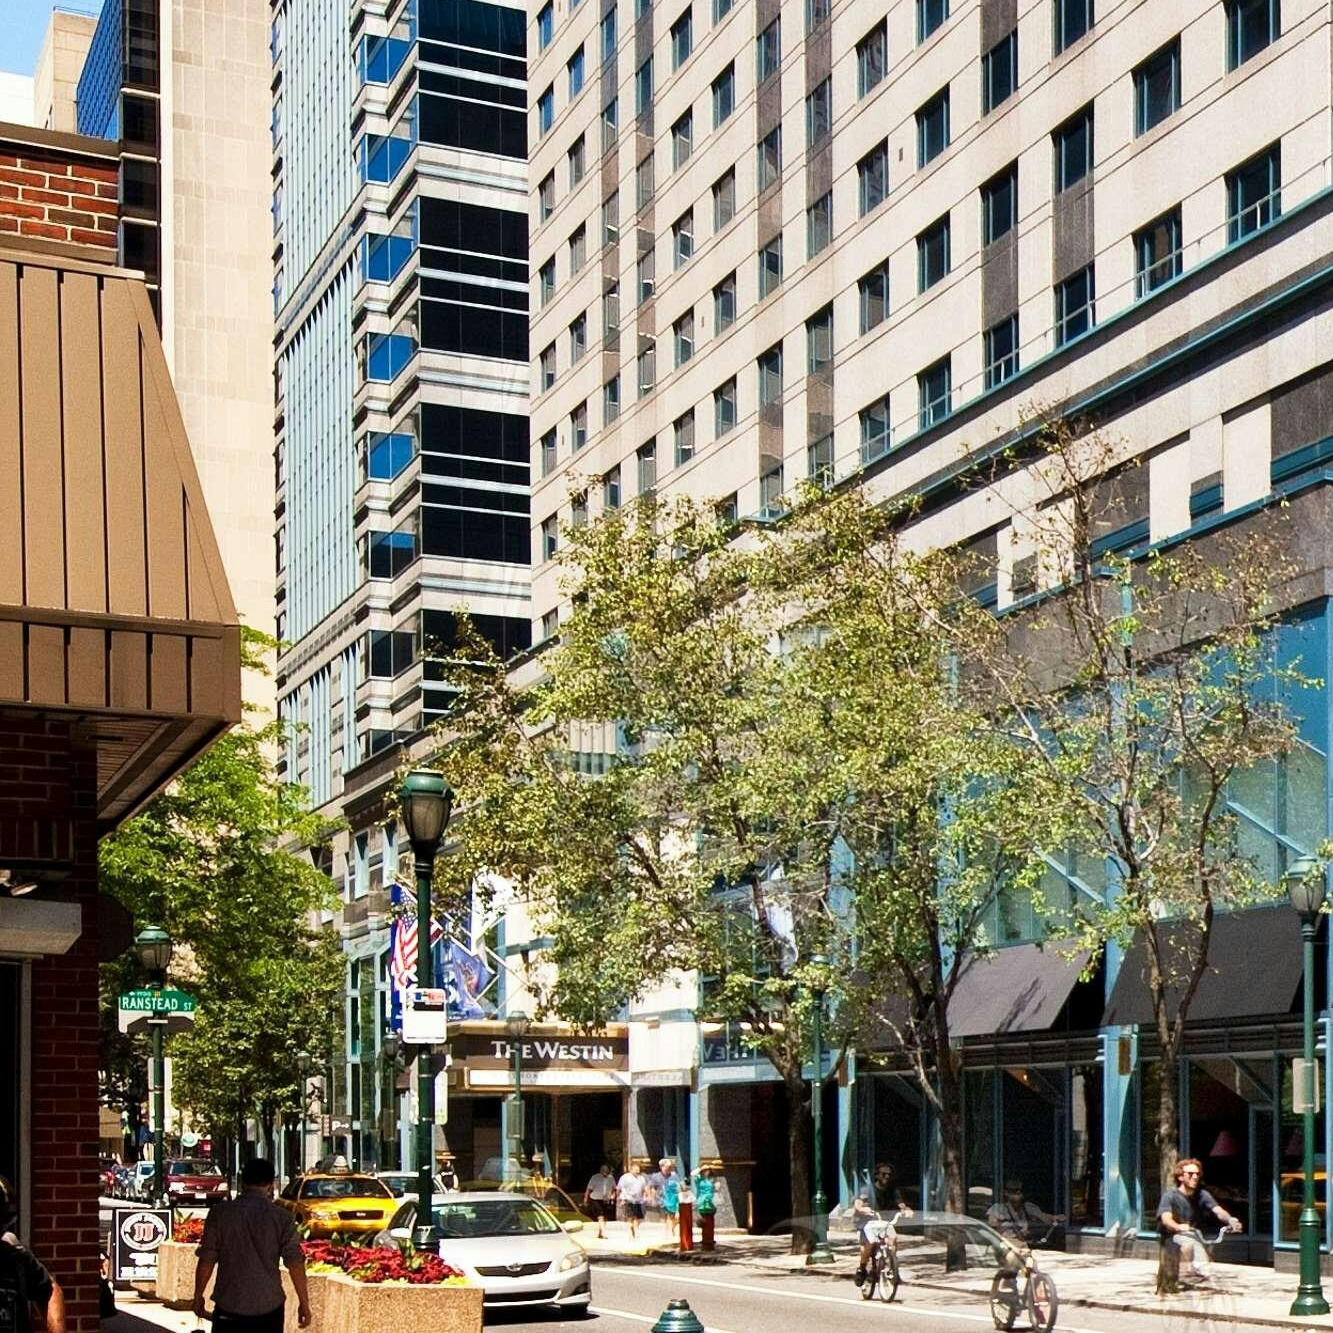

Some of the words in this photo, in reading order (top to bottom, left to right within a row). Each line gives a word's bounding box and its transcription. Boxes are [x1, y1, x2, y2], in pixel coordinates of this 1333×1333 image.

[122, 996, 178, 1010] RANSTEAD
[183, 1002, 192, 1011] ST
[491, 1040, 532, 1059] THE
[533, 1041, 614, 1060] WESTIN
